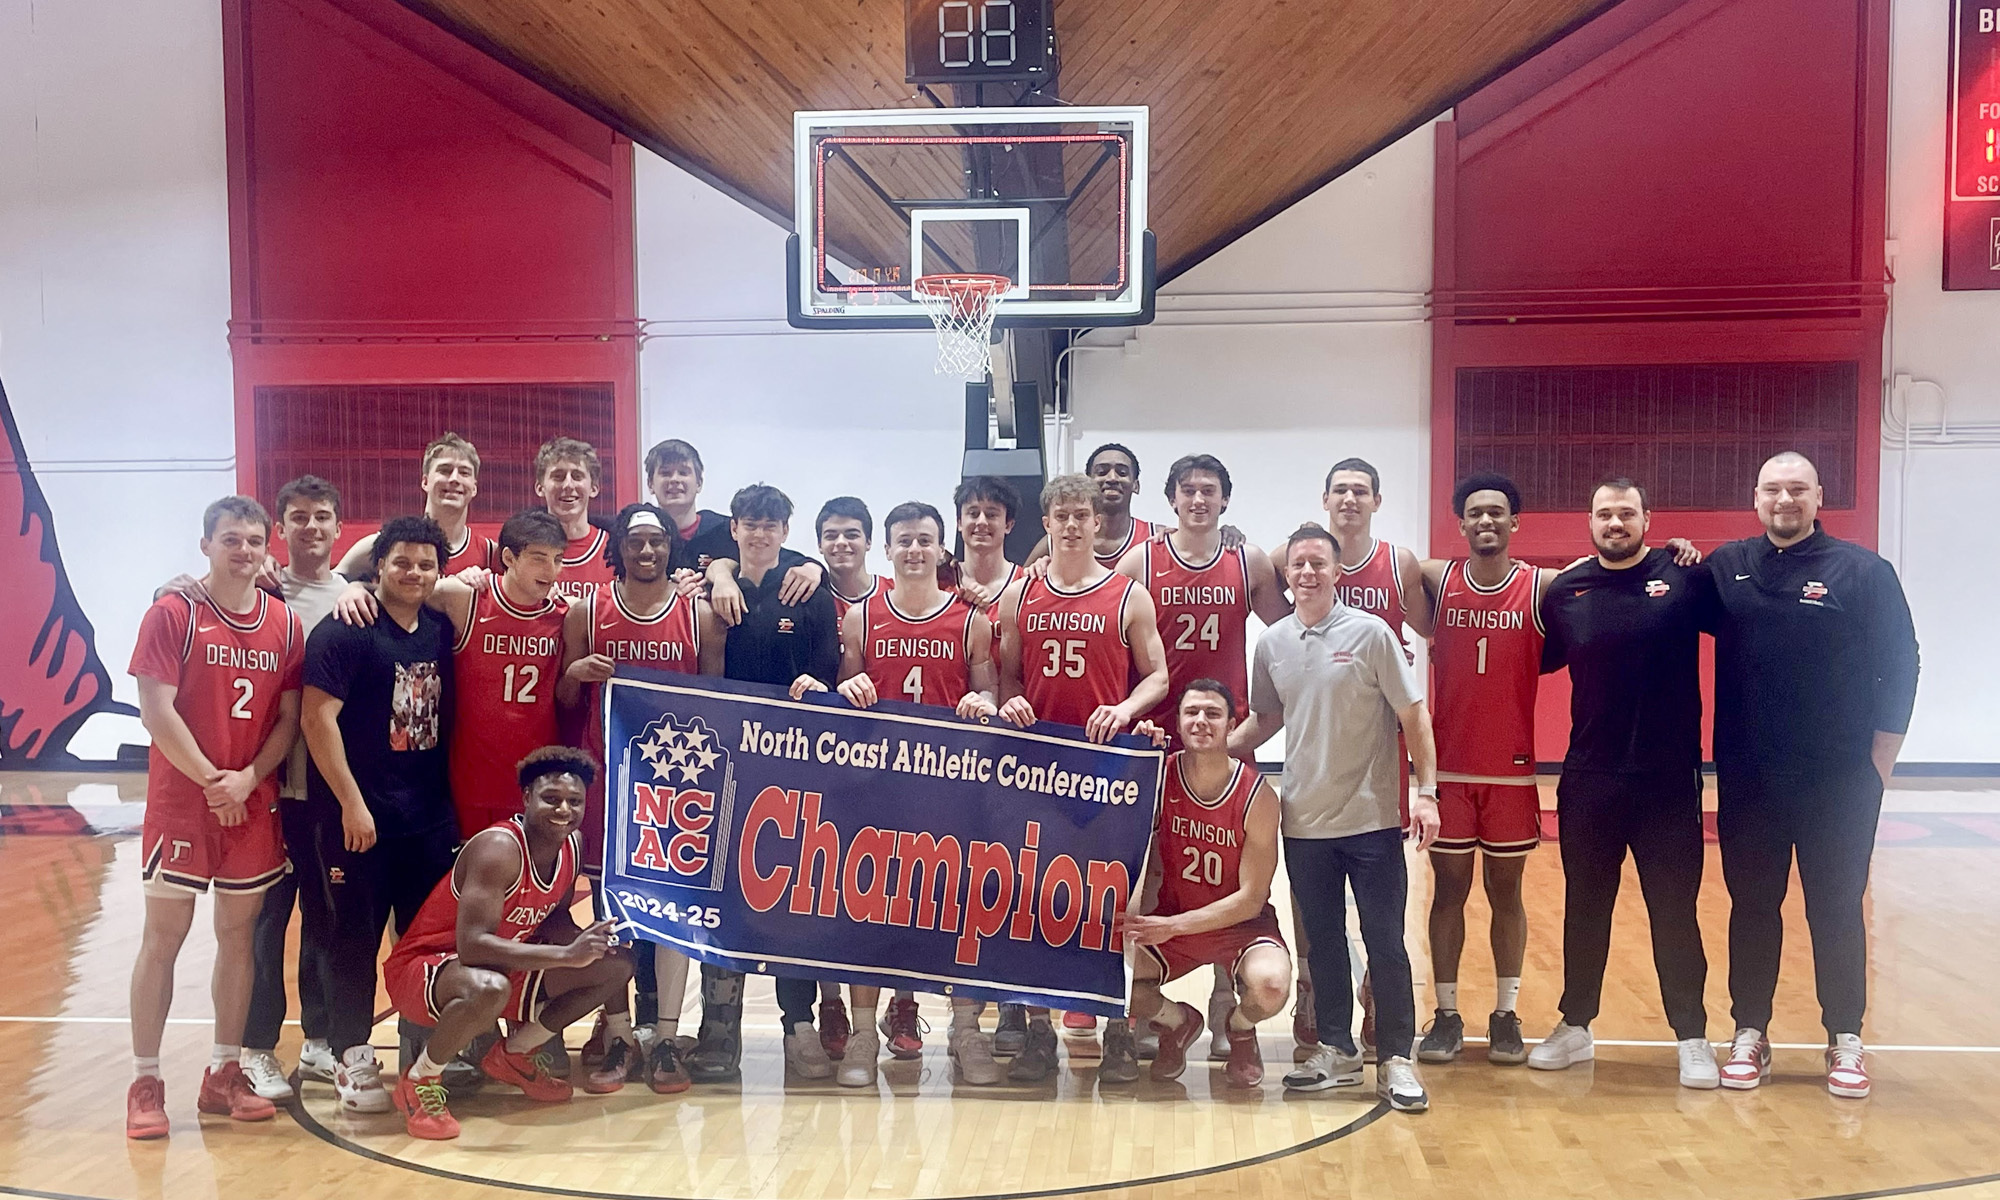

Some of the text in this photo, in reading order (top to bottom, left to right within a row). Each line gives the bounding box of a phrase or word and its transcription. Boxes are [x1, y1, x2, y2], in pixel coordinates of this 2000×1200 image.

[812, 305, 846, 315] SPALDING
[1161, 586, 1236, 606] DENISON
[1334, 585, 1389, 610] NISON
[1027, 612, 1106, 634] DENISON
[1175, 613, 1220, 651] 24
[1446, 608, 1524, 630] DENISON
[206, 643, 279, 673] DENISON
[483, 633, 559, 656] DENISON
[606, 640, 683, 661] DENISON
[875, 638, 954, 660] DENISON
[1042, 639, 1087, 678] 35
[1476, 637, 1488, 674] 1
[231, 677, 254, 719] 2
[503, 664, 539, 703] 12
[903, 665, 924, 704] 4
[739, 719, 1140, 806] North Coast Athletic Conference
[632, 781, 716, 834] NC
[1171, 815, 1238, 848] DENISON
[631, 825, 710, 877] AC
[1182, 846, 1223, 886] 20
[738, 785, 1131, 966] Champion
[618, 890, 722, 929] 2024-25
